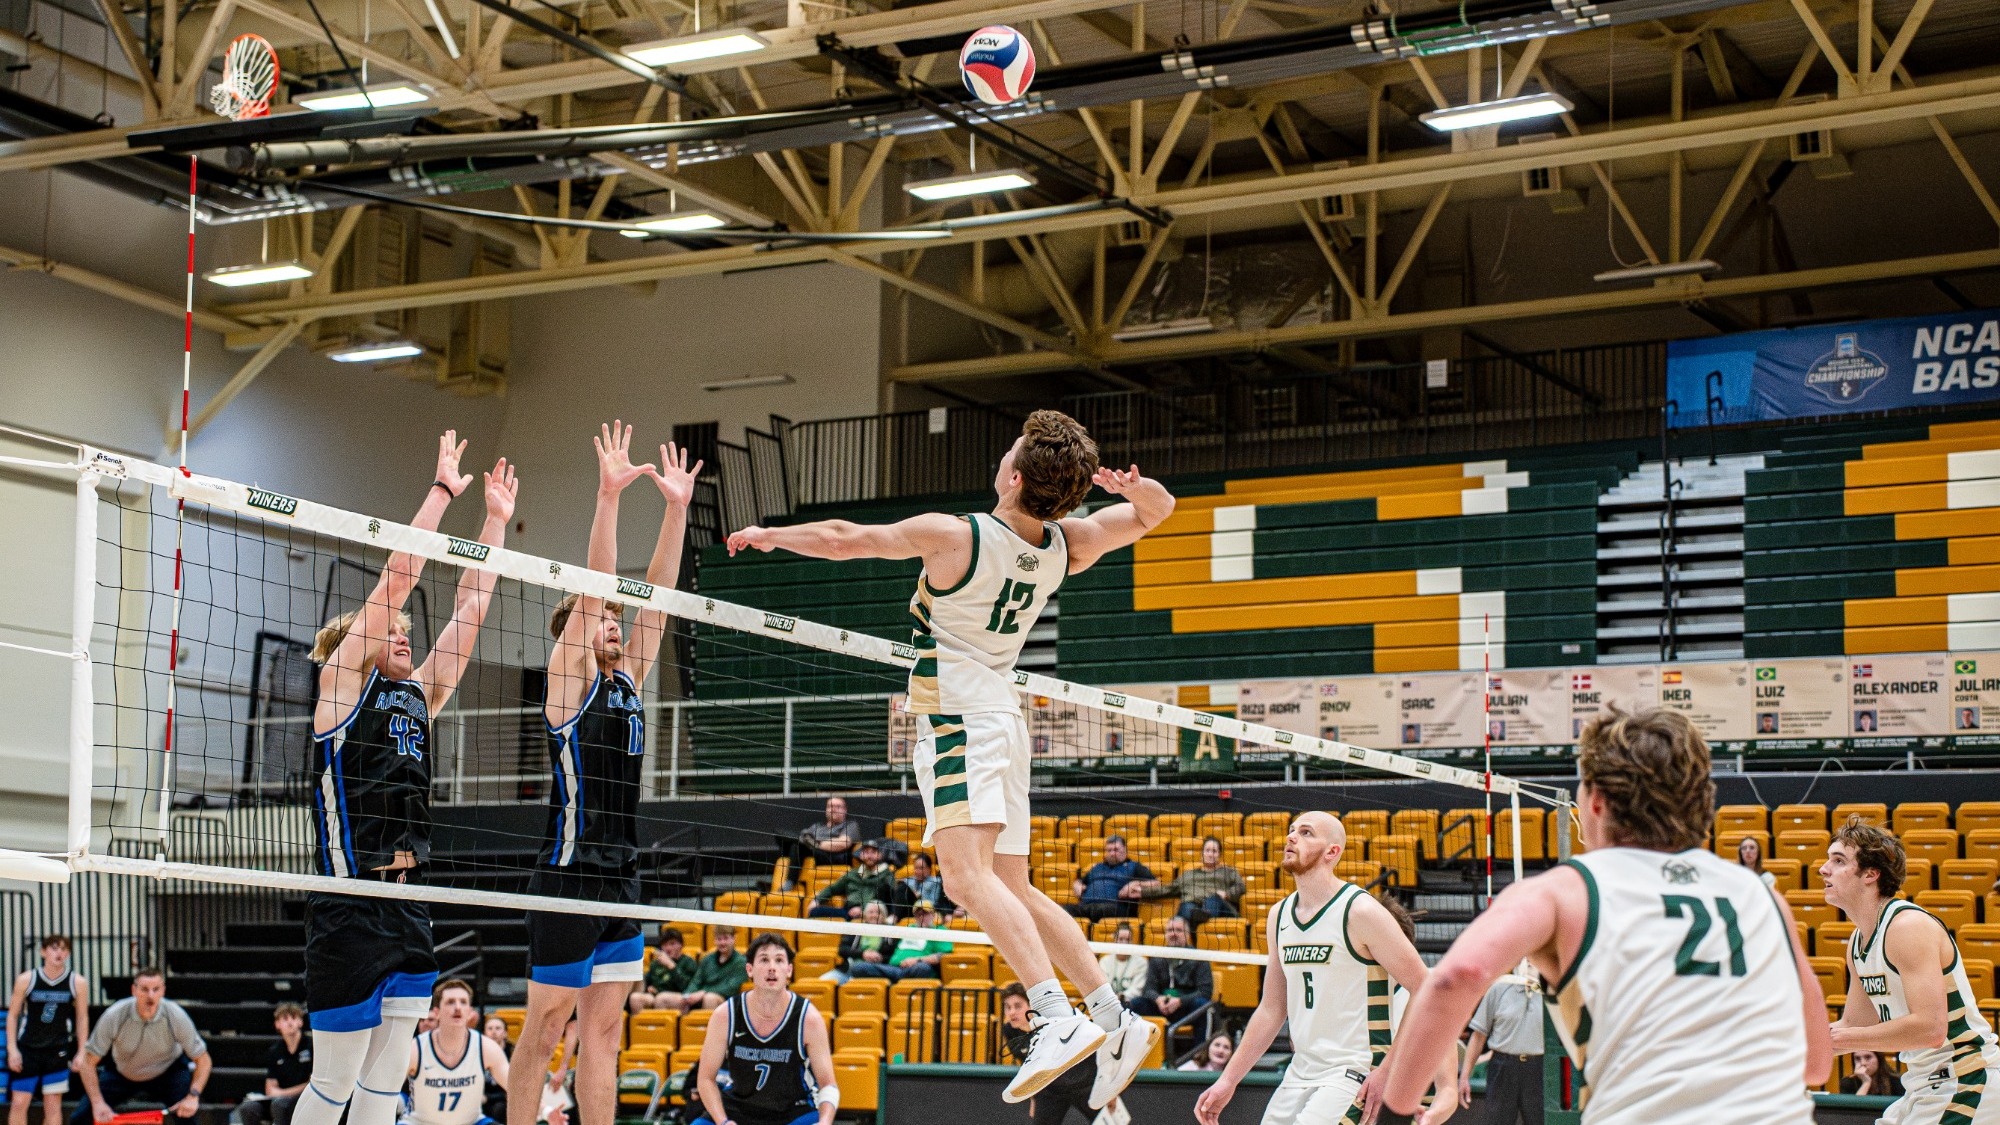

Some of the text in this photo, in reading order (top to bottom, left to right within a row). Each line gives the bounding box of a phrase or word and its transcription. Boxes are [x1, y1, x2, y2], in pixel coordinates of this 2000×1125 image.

[1912, 320, 2000, 359] NCA
[1807, 366, 1887, 384] CHAMPIONSHIP
[1912, 356, 2000, 394] BAS
[249, 490, 296, 514] MINERS
[450, 540, 488, 560] MINERS
[619, 580, 652, 598] MINERS
[985, 577, 1036, 634] 12
[766, 615, 794, 631] MINERS
[893, 644, 918, 659] MINERS
[1756, 686, 1785, 698] LUIZ
[1853, 681, 1938, 695] ALEXANDER
[1955, 679, 2000, 692] JULIA
[1402, 698, 1435, 710] ISAAC
[1573, 692, 1601, 704] MIKE
[1663, 689, 1691, 701] IKER
[1320, 701, 1351, 713] ANDY
[389, 713, 425, 761] 42
[1660, 894, 1747, 977] 21
[1284, 946, 1330, 964] MINERS
[1303, 971, 1314, 1009] 6
[734, 1045, 793, 1063] ROCKHURST
[424, 1075, 476, 1088] ROCKHURST
[754, 1063, 770, 1091] 7
[438, 1091, 462, 1112] 17
